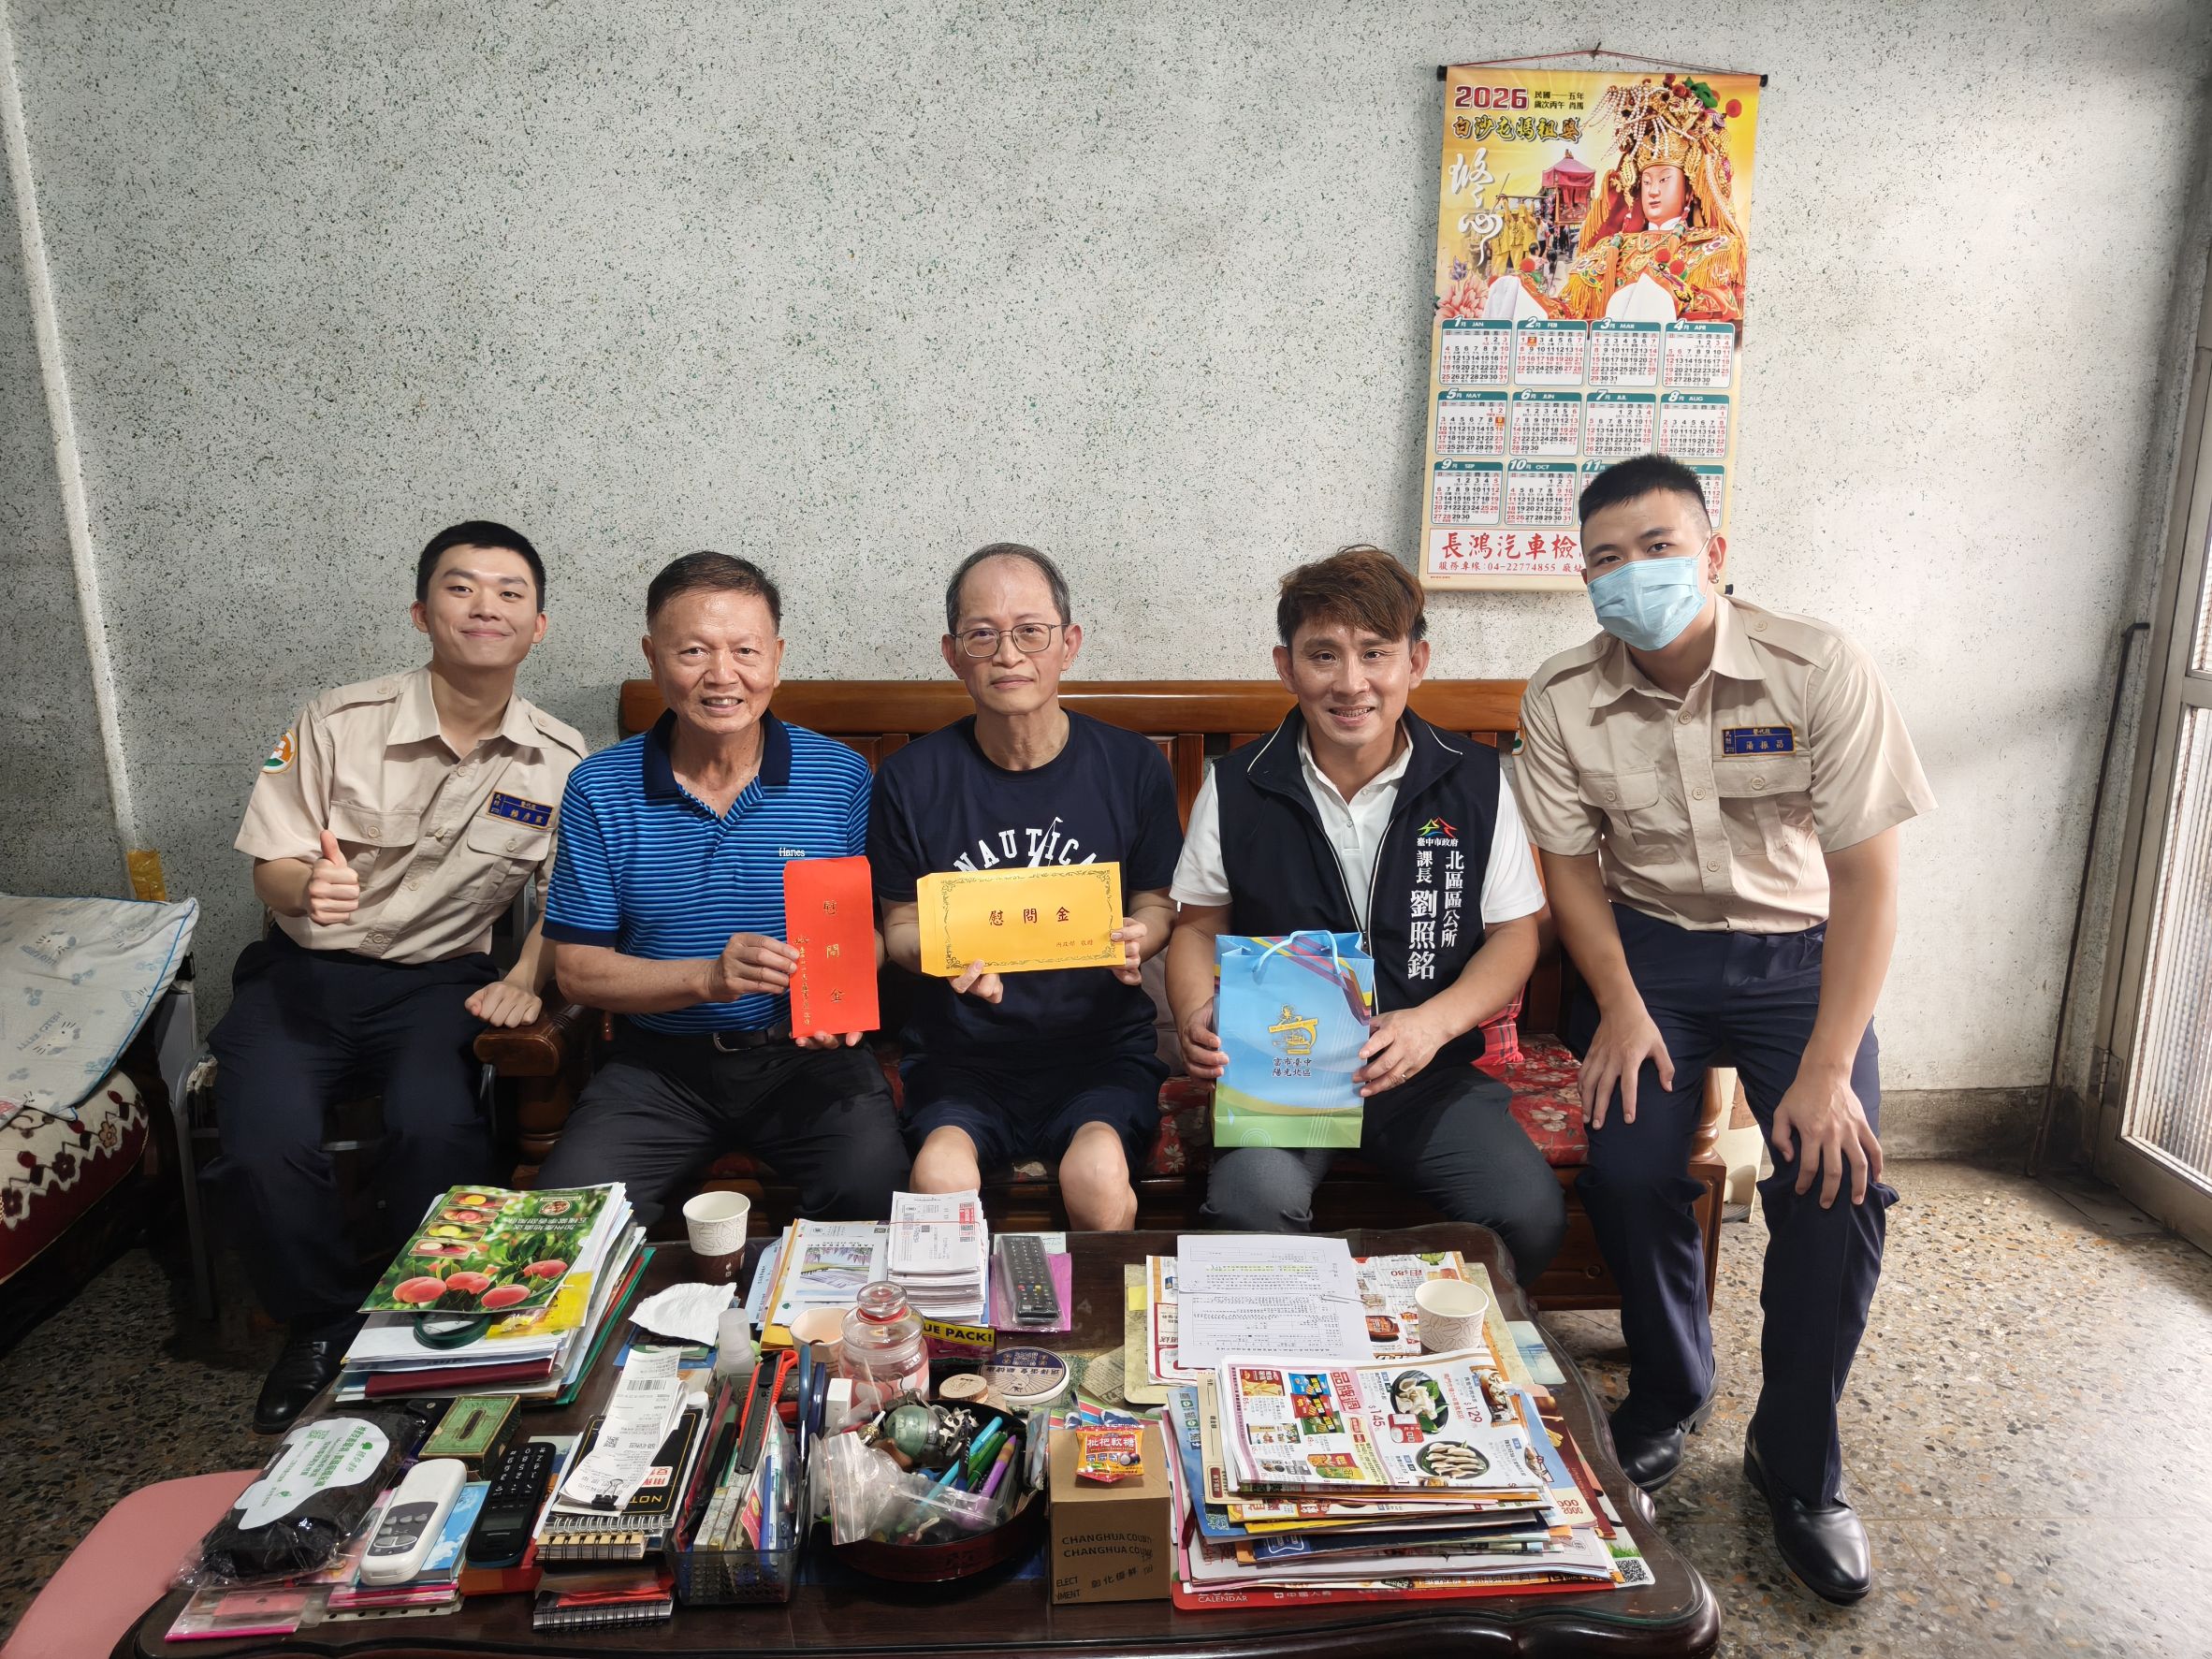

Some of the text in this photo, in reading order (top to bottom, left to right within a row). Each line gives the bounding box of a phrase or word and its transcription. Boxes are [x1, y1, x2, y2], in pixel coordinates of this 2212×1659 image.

[1455, 86, 1527, 109] 2026
[1453, 115, 1581, 143] 白沙屯媽祖婆
[1446, 389, 1462, 399] 5月
[1521, 390, 1536, 400] 6月
[1596, 390, 1610, 400] 7月
[1668, 392, 1684, 402] 8月
[1510, 460, 1531, 470] 10月
[1442, 532, 1582, 560] 長鴻汽車檢
[1416, 837, 1459, 847] 臺中市政府
[779, 847, 805, 857] Hanes
[1441, 850, 1465, 948] 北區區公所
[988, 906, 1071, 927] 慰問金
[1407, 850, 1438, 980] 課長 劉照銘
[823, 900, 845, 1002] 慰問金
[946, 1328, 992, 1342] PACK!
[1368, 1405, 1385, 1427] $145
[1463, 1402, 1482, 1423] $129
[1062, 1533, 1125, 1545] CHANGHUA
[1063, 1546, 1127, 1557] CHANGHUA
[1056, 1577, 1078, 1587] ELECT
